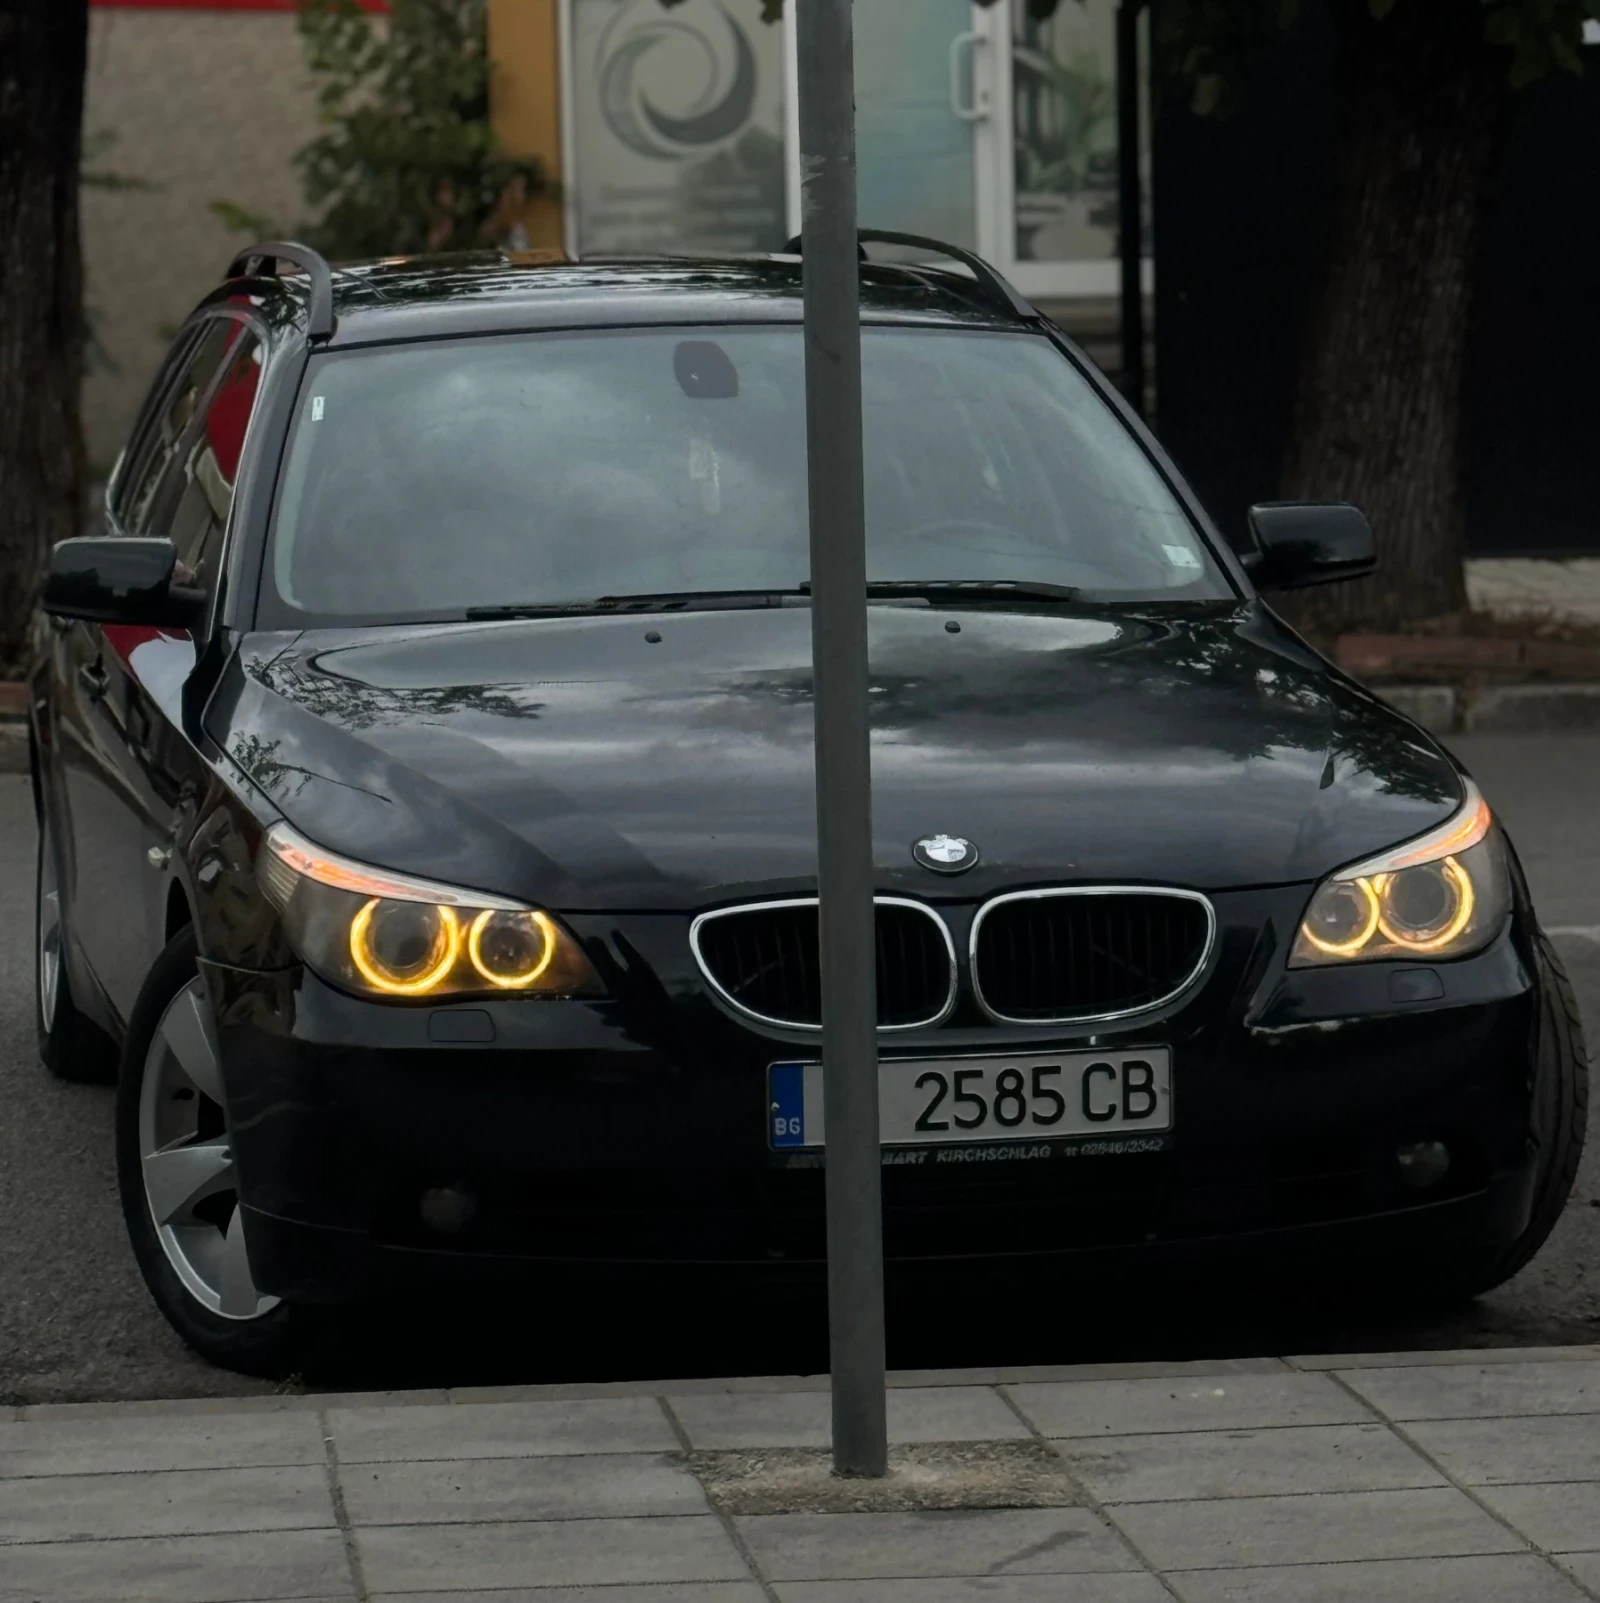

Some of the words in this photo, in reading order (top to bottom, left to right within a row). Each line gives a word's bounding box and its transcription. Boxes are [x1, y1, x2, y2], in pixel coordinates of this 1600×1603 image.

[914, 1065, 1065, 1131] 2585
[1082, 1060, 1157, 1122] CB
[774, 1117, 801, 1136] BG
[935, 1144, 1051, 1163] KIRCHSCHLAG
